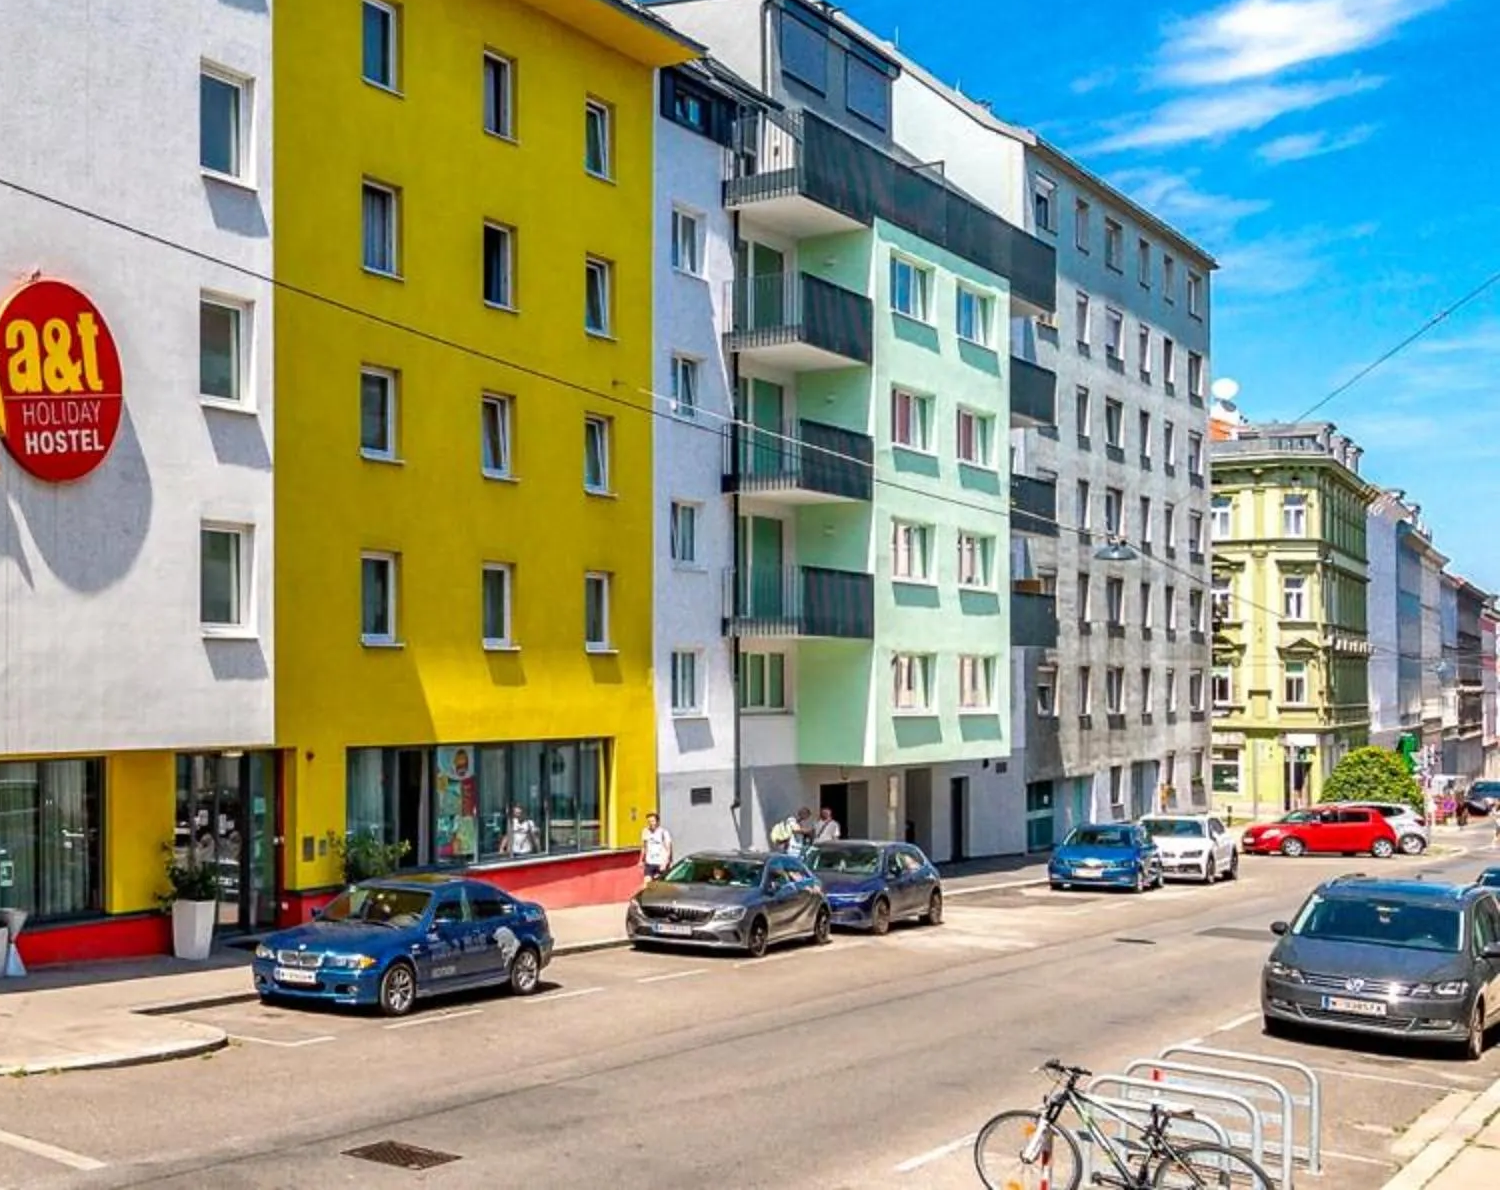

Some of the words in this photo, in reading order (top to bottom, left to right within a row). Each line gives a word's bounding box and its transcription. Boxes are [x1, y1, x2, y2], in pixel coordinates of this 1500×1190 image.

[4, 312, 104, 394] a&t
[22, 400, 101, 425] HOLIDAY
[25, 429, 105, 455] HOSTEL
